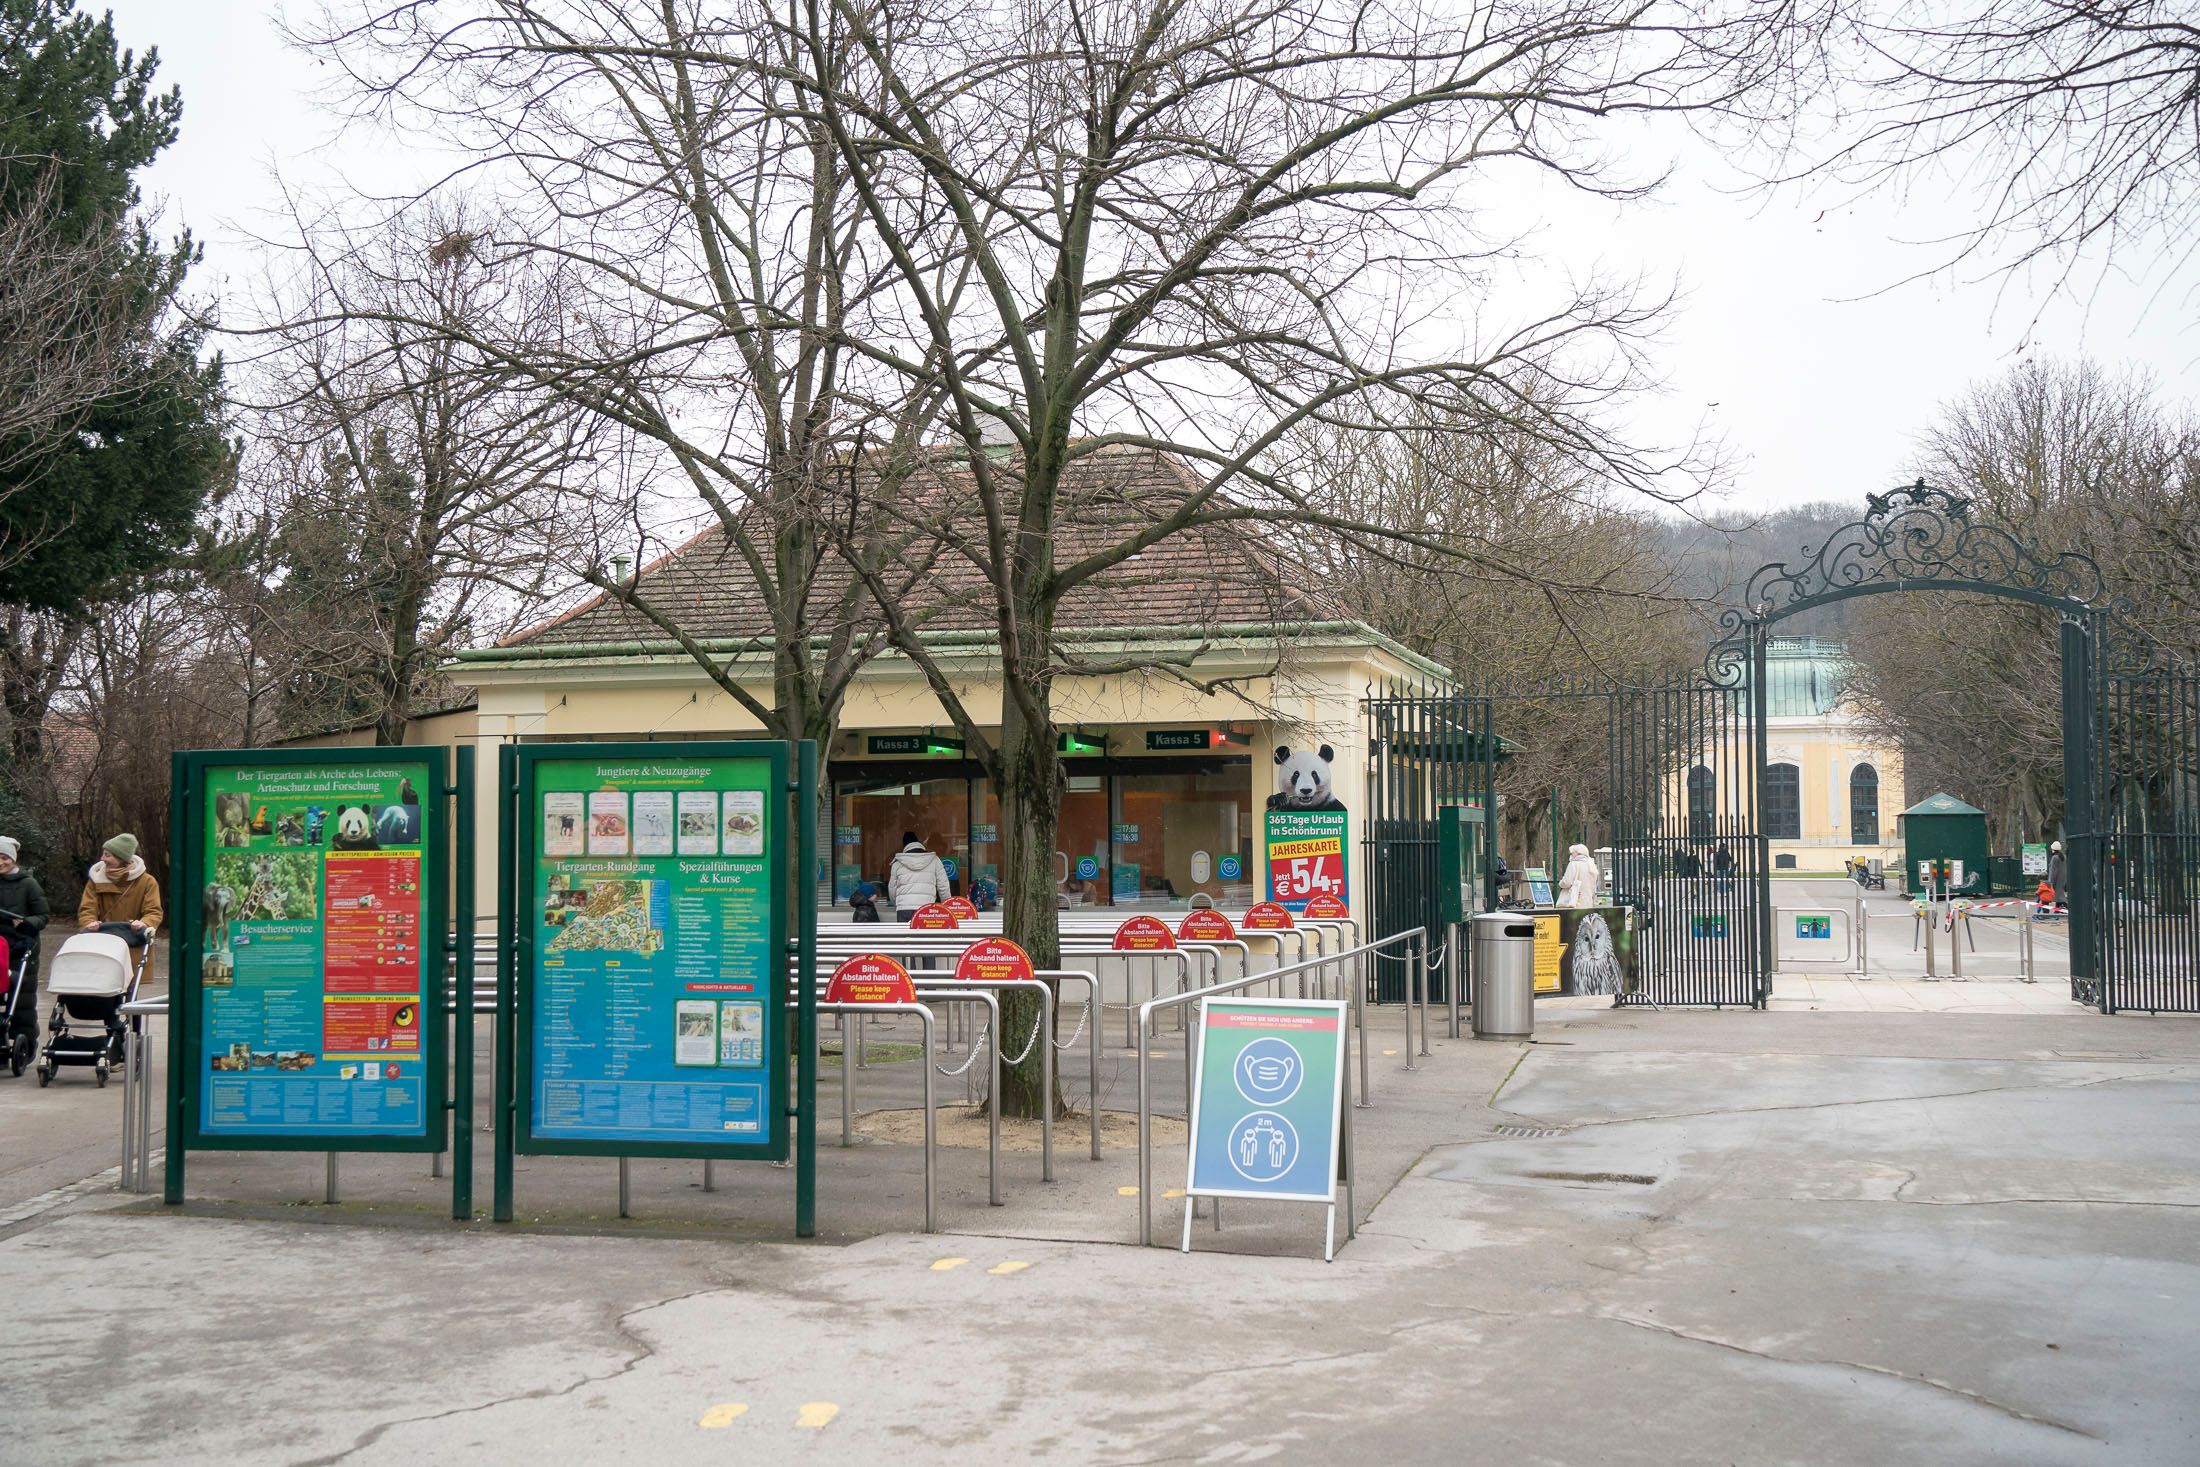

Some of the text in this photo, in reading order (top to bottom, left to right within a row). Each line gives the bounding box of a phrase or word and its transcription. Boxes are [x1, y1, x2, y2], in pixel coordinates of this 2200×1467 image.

[876, 738, 919, 749] Kassa 3
[1156, 734, 1201, 745] Kassa 5
[237, 768, 402, 782] Der Tiergarten als Arche des Lebens:
[596, 766, 711, 779] Jungtiere & Neuzugänge
[257, 781, 380, 793] Artenschutz und Forschung
[1269, 814, 1344, 825] 365 Tage Urlaub
[1272, 826, 1342, 835] in Schönbrunn!
[1272, 840, 1338, 856] JAHRESKARTE
[554, 861, 655, 874] Tiergarten-Rundgang
[680, 862, 763, 873] Spezialführungen
[700, 874, 741, 883] & Kurse
[1275, 873, 1290, 881] Jetzt
[1276, 881, 1290, 896] €
[240, 924, 314, 934] Besucherservice
[874, 985, 891, 993] keep
